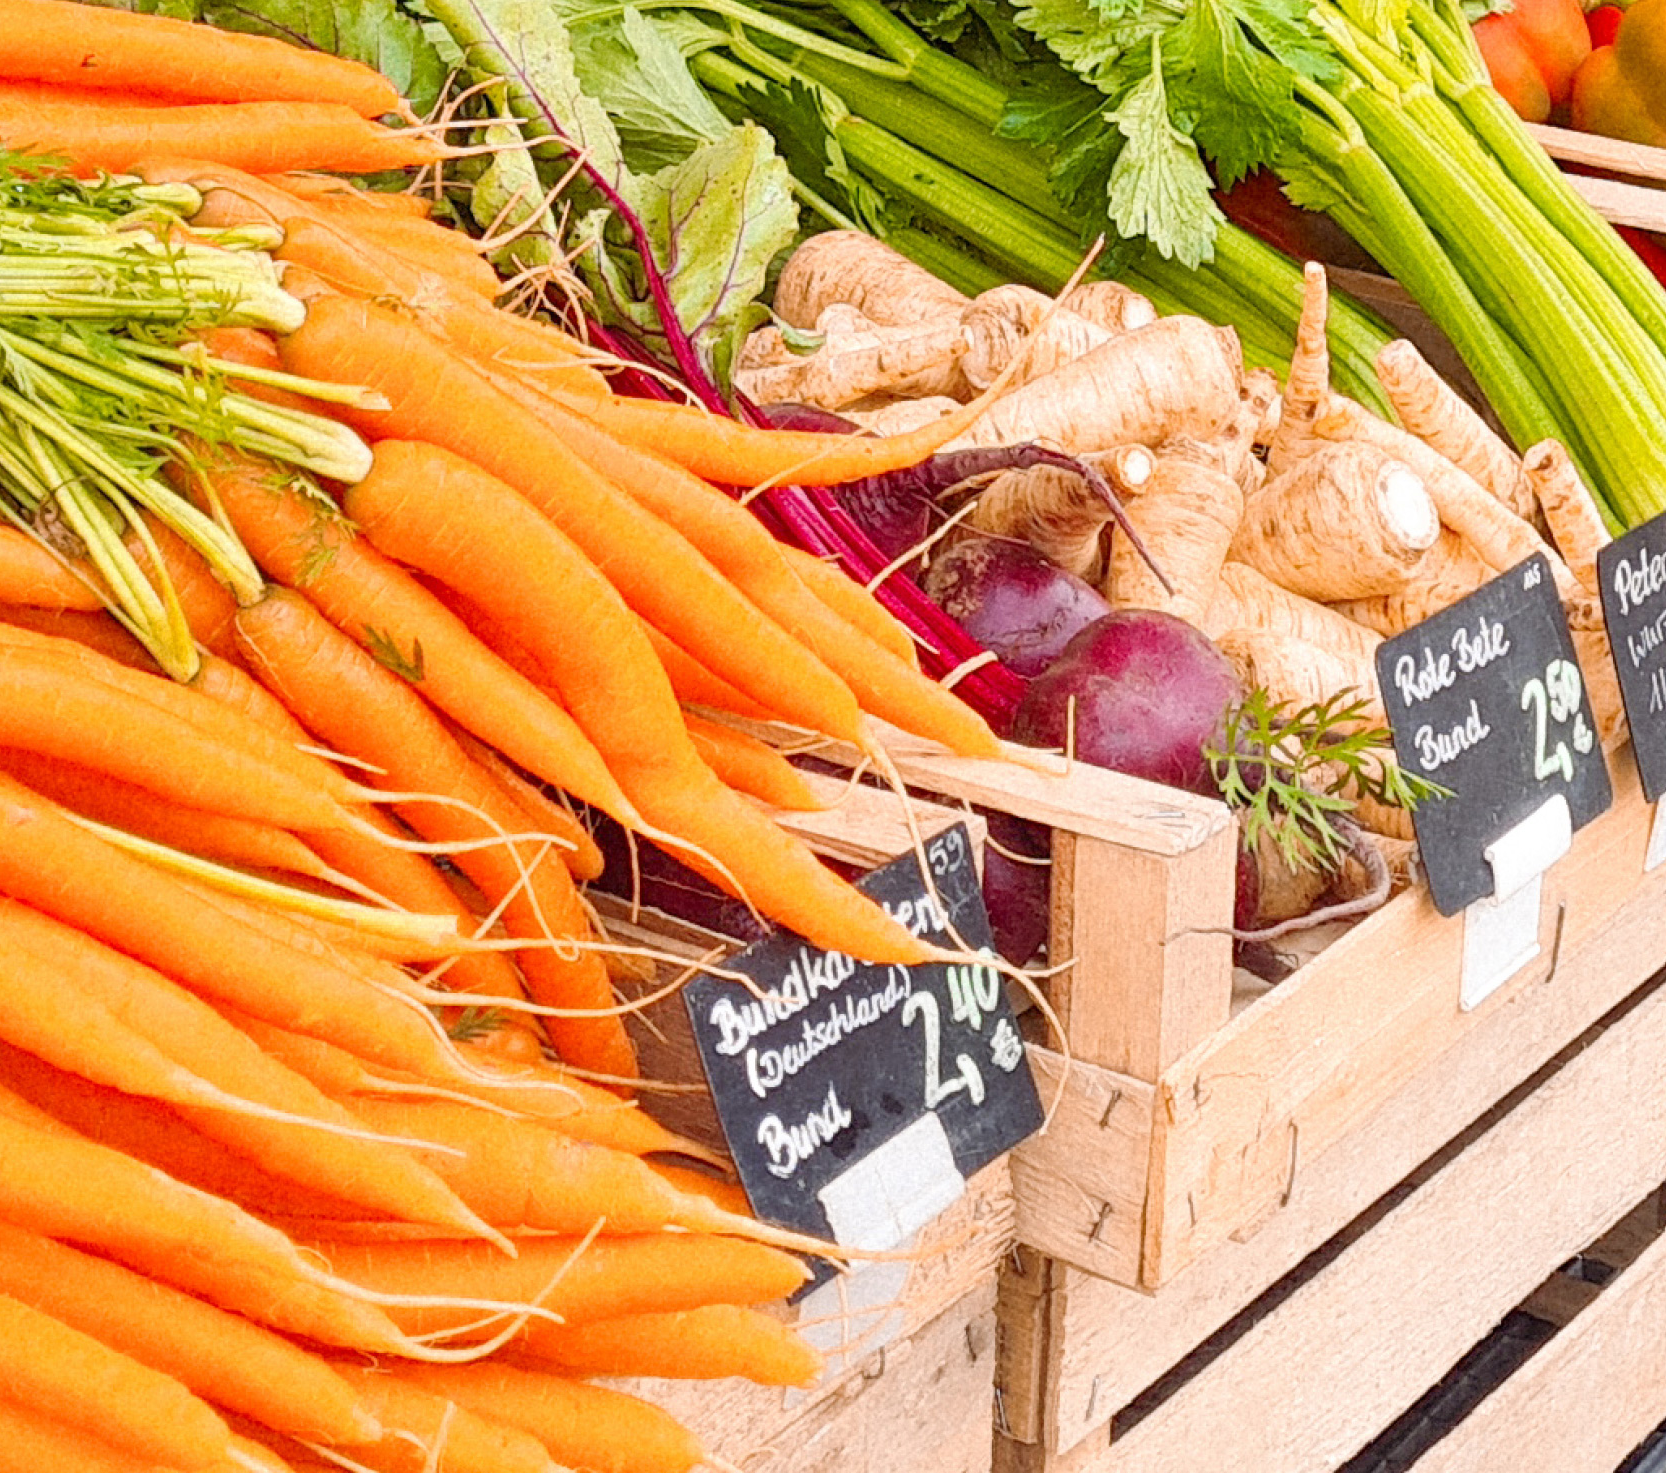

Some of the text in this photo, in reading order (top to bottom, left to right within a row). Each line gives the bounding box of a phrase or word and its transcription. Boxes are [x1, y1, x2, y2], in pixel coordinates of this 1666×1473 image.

[1395, 616, 1511, 708] Rote Bete
[1414, 698, 1491, 771] Bund
[929, 830, 965, 876] 59
[757, 1080, 853, 1178] Bund
